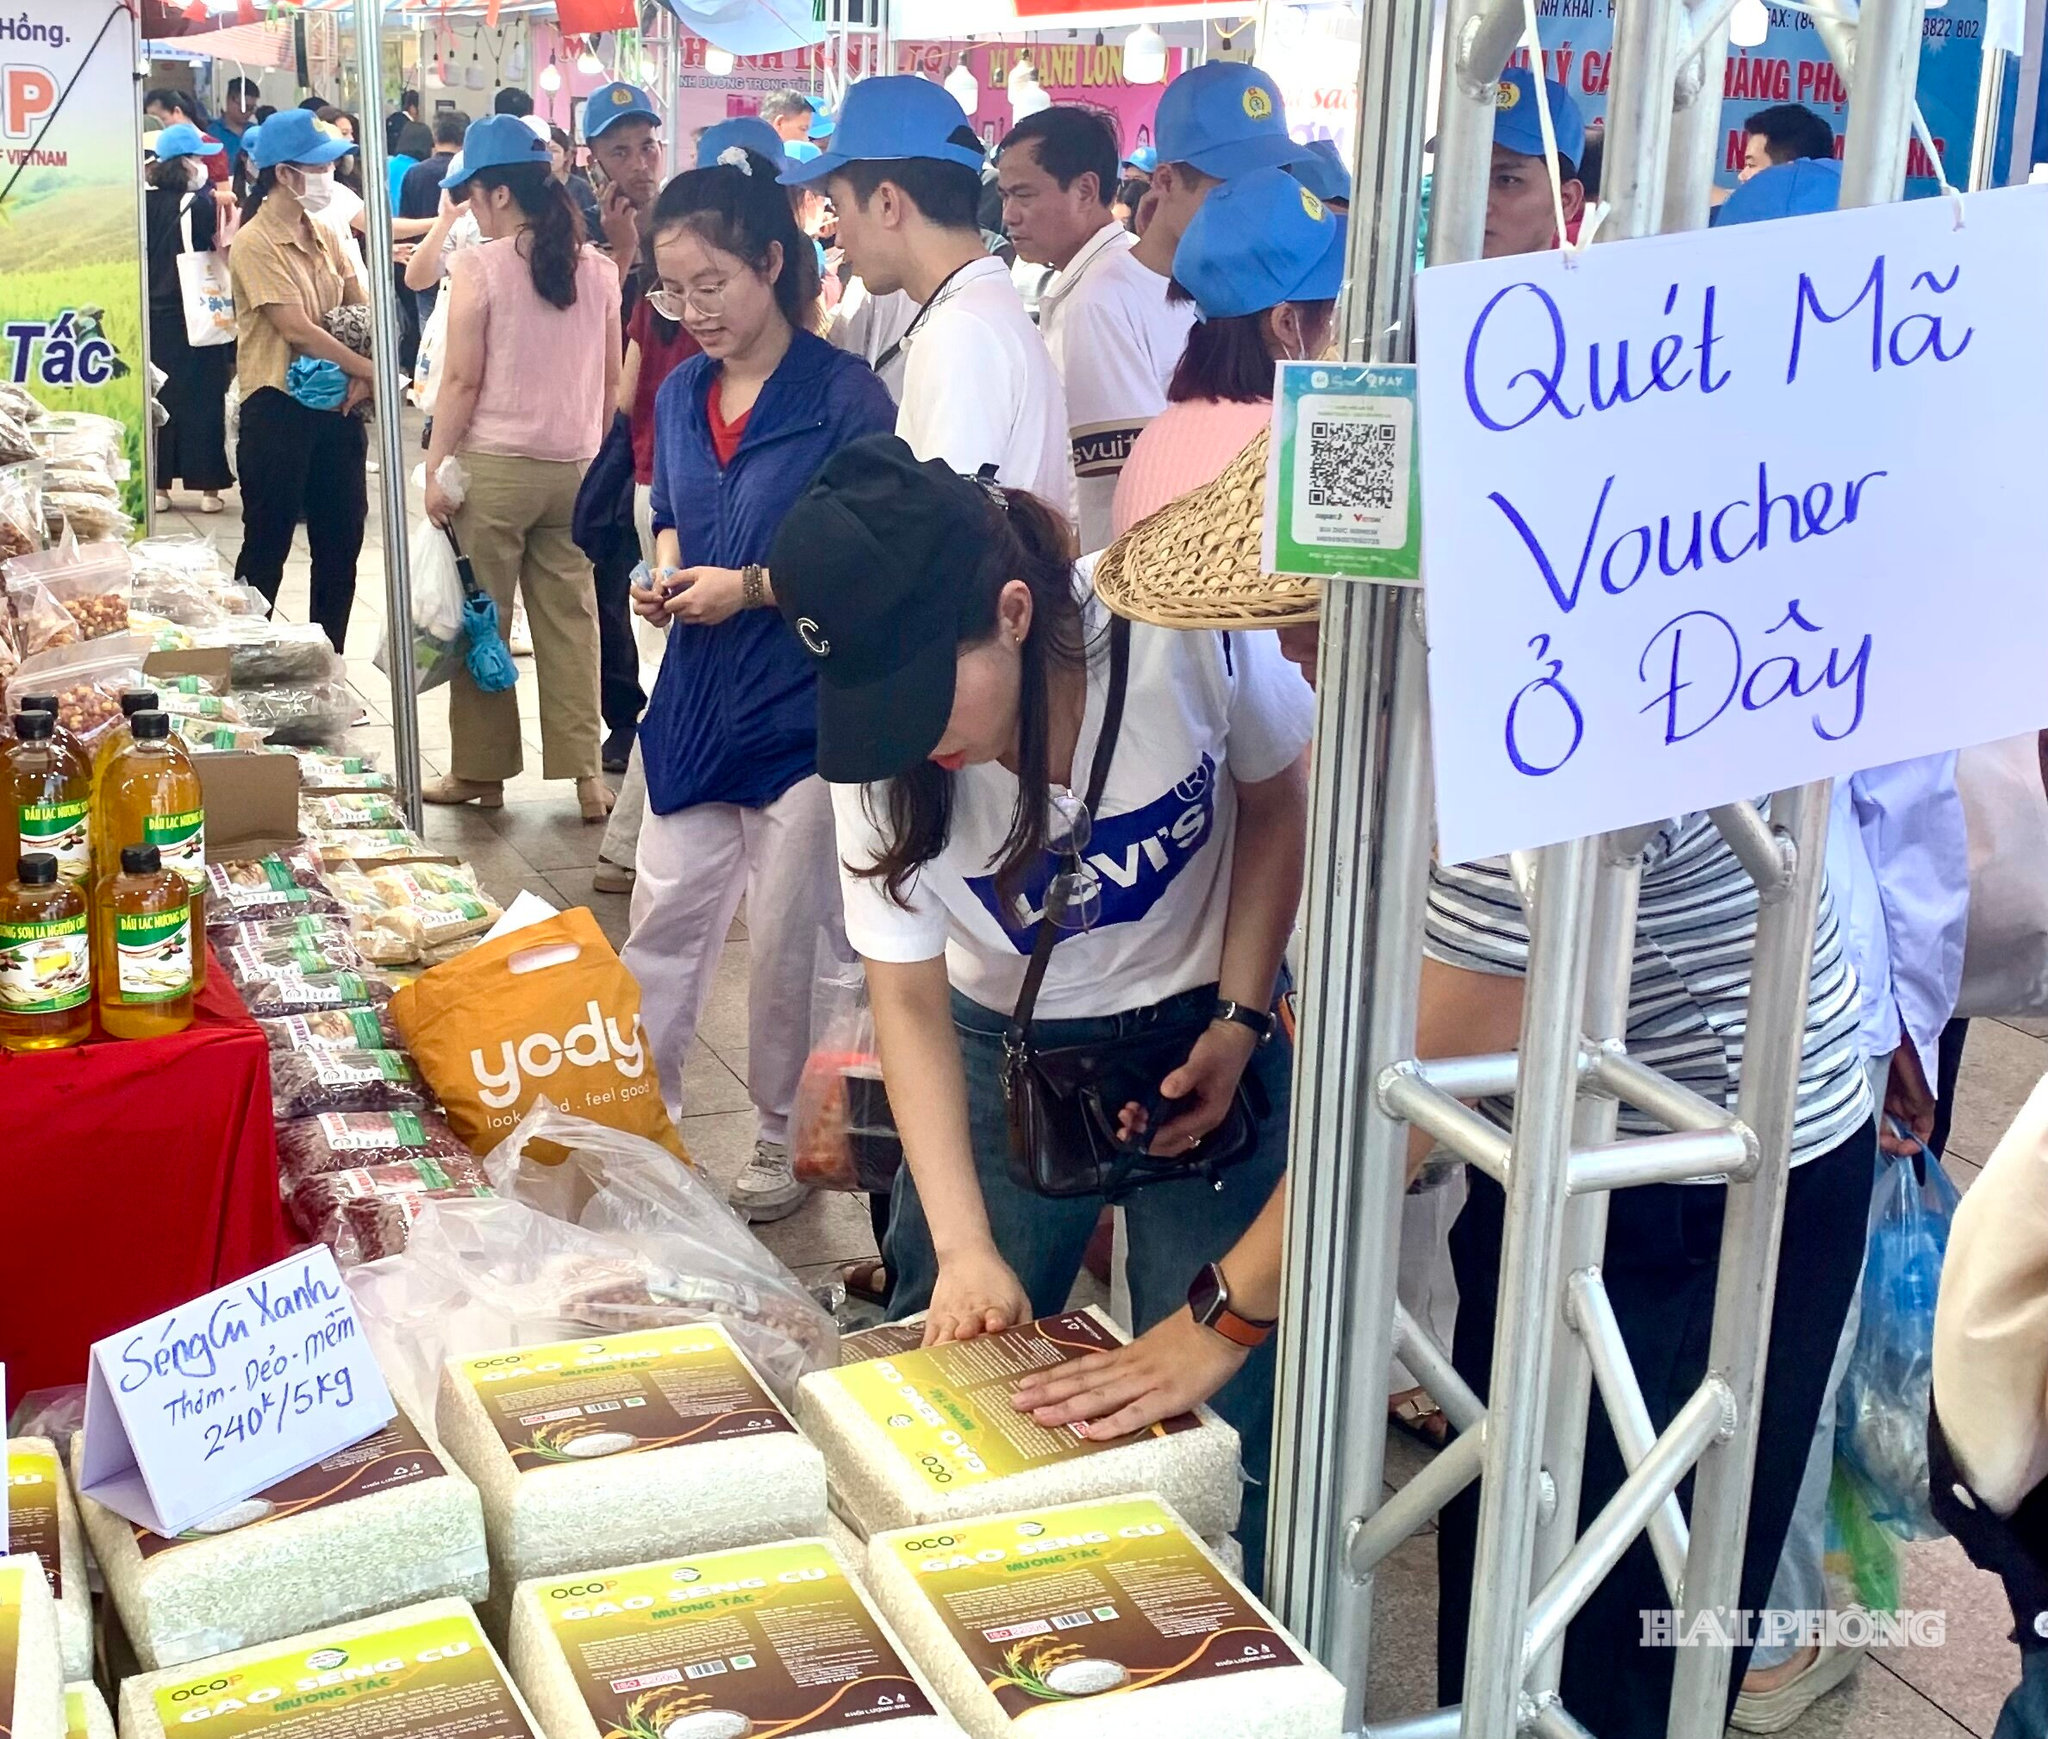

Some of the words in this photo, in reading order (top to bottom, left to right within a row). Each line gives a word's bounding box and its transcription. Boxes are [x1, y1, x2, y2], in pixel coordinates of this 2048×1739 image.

[0, 12, 71, 48] Hồng.
[1956, 21, 1980, 39] 802
[7, 150, 68, 167] VIETNAM
[6, 311, 113, 384] Tấc
[1463, 282, 1733, 432] Quét
[1786, 253, 1976, 384] Mã
[1486, 461, 1889, 614] Voucher
[1637, 598, 1874, 747] Đây
[36, 926, 47, 938] LA
[469, 999, 645, 1109] yody
[485, 1109, 523, 1130] look
[584, 1086, 616, 1107] feel
[246, 1264, 341, 1328] Xanh
[904, 1533, 967, 1552] OCOP
[550, 1579, 619, 1600] OCOP
[170, 1673, 245, 1702] OCOP
